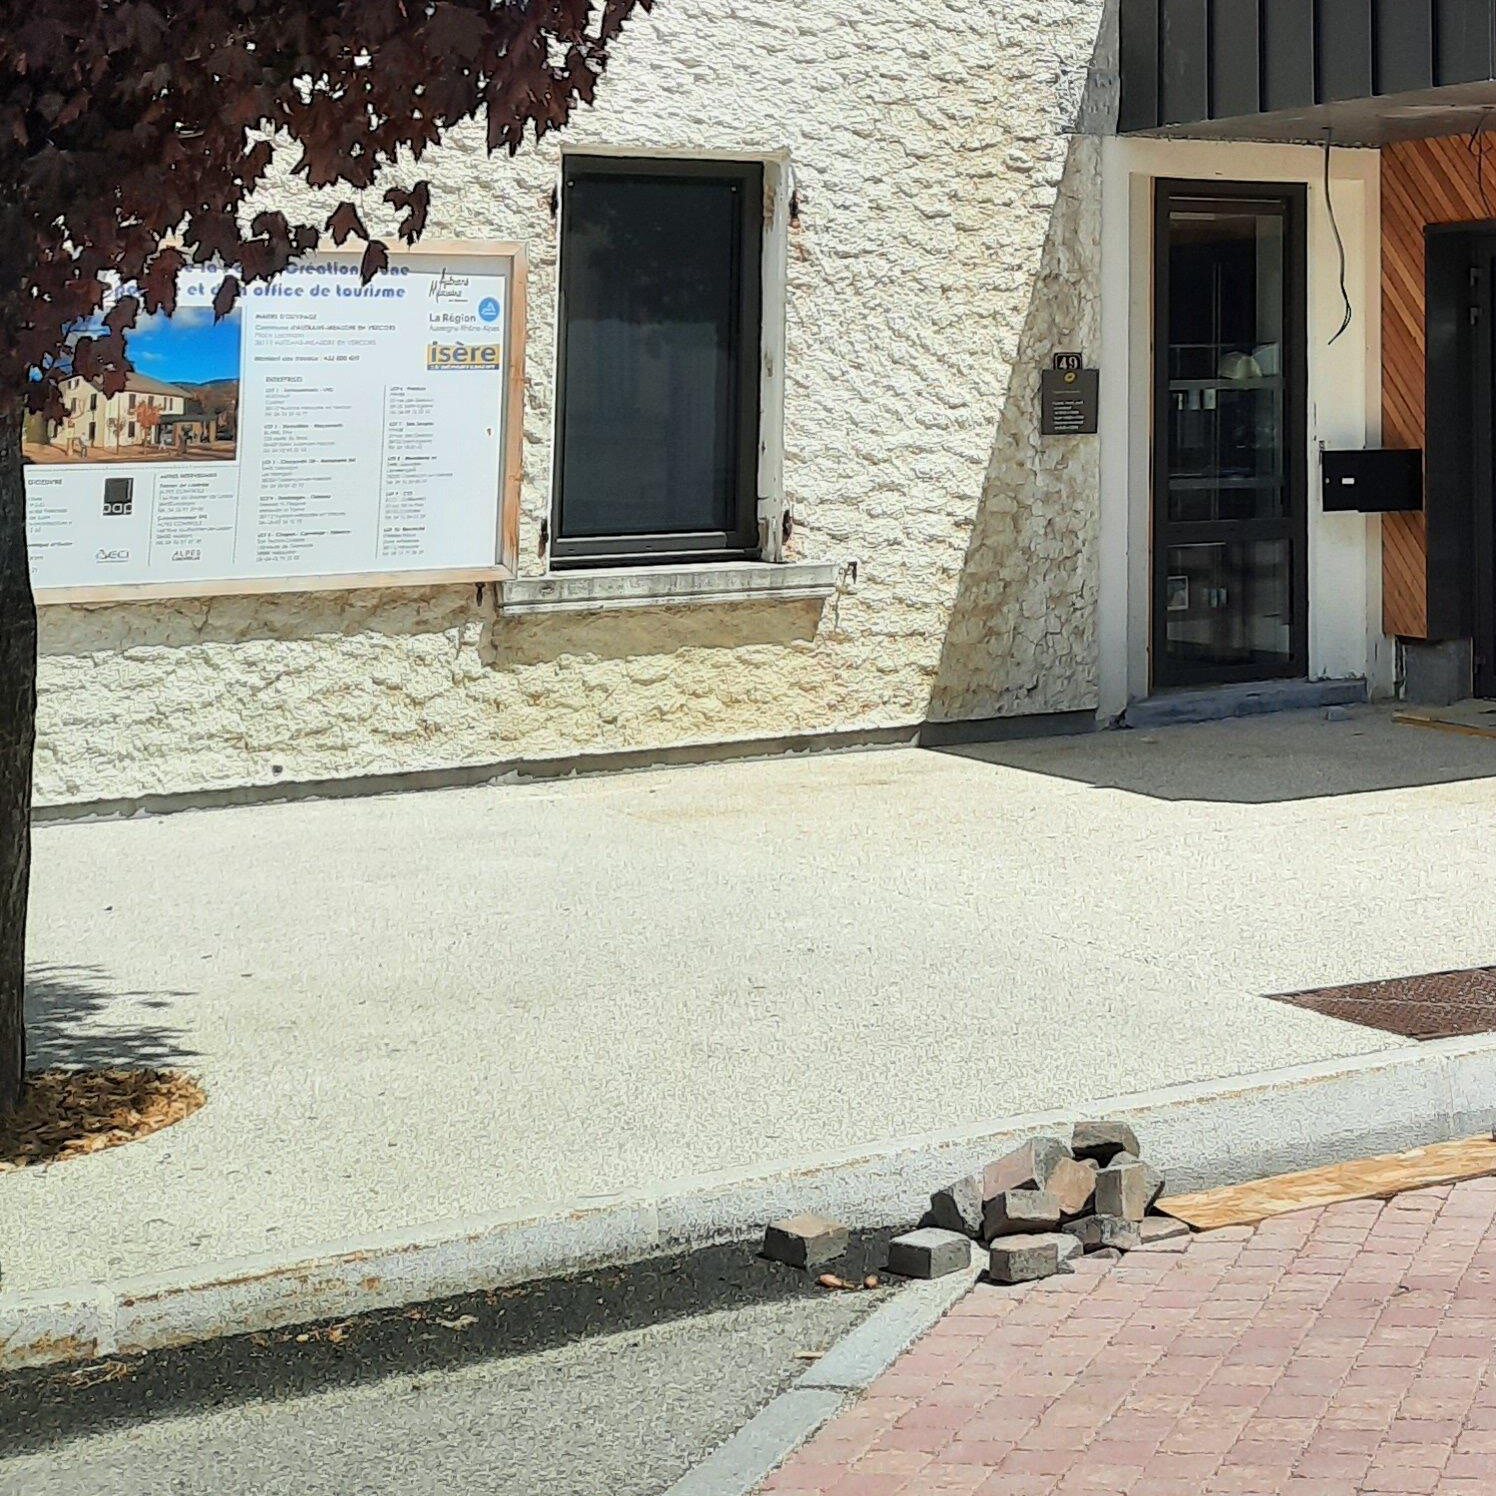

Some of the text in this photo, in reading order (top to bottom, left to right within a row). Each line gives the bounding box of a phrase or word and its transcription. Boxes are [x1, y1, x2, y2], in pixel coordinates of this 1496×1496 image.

[187, 282, 205, 296] et
[253, 283, 305, 297] office
[309, 283, 331, 298] de
[336, 284, 406, 299] tourisme
[429, 312, 477, 324] La Région
[431, 340, 497, 363] isère
[1059, 356, 1078, 370] 49
